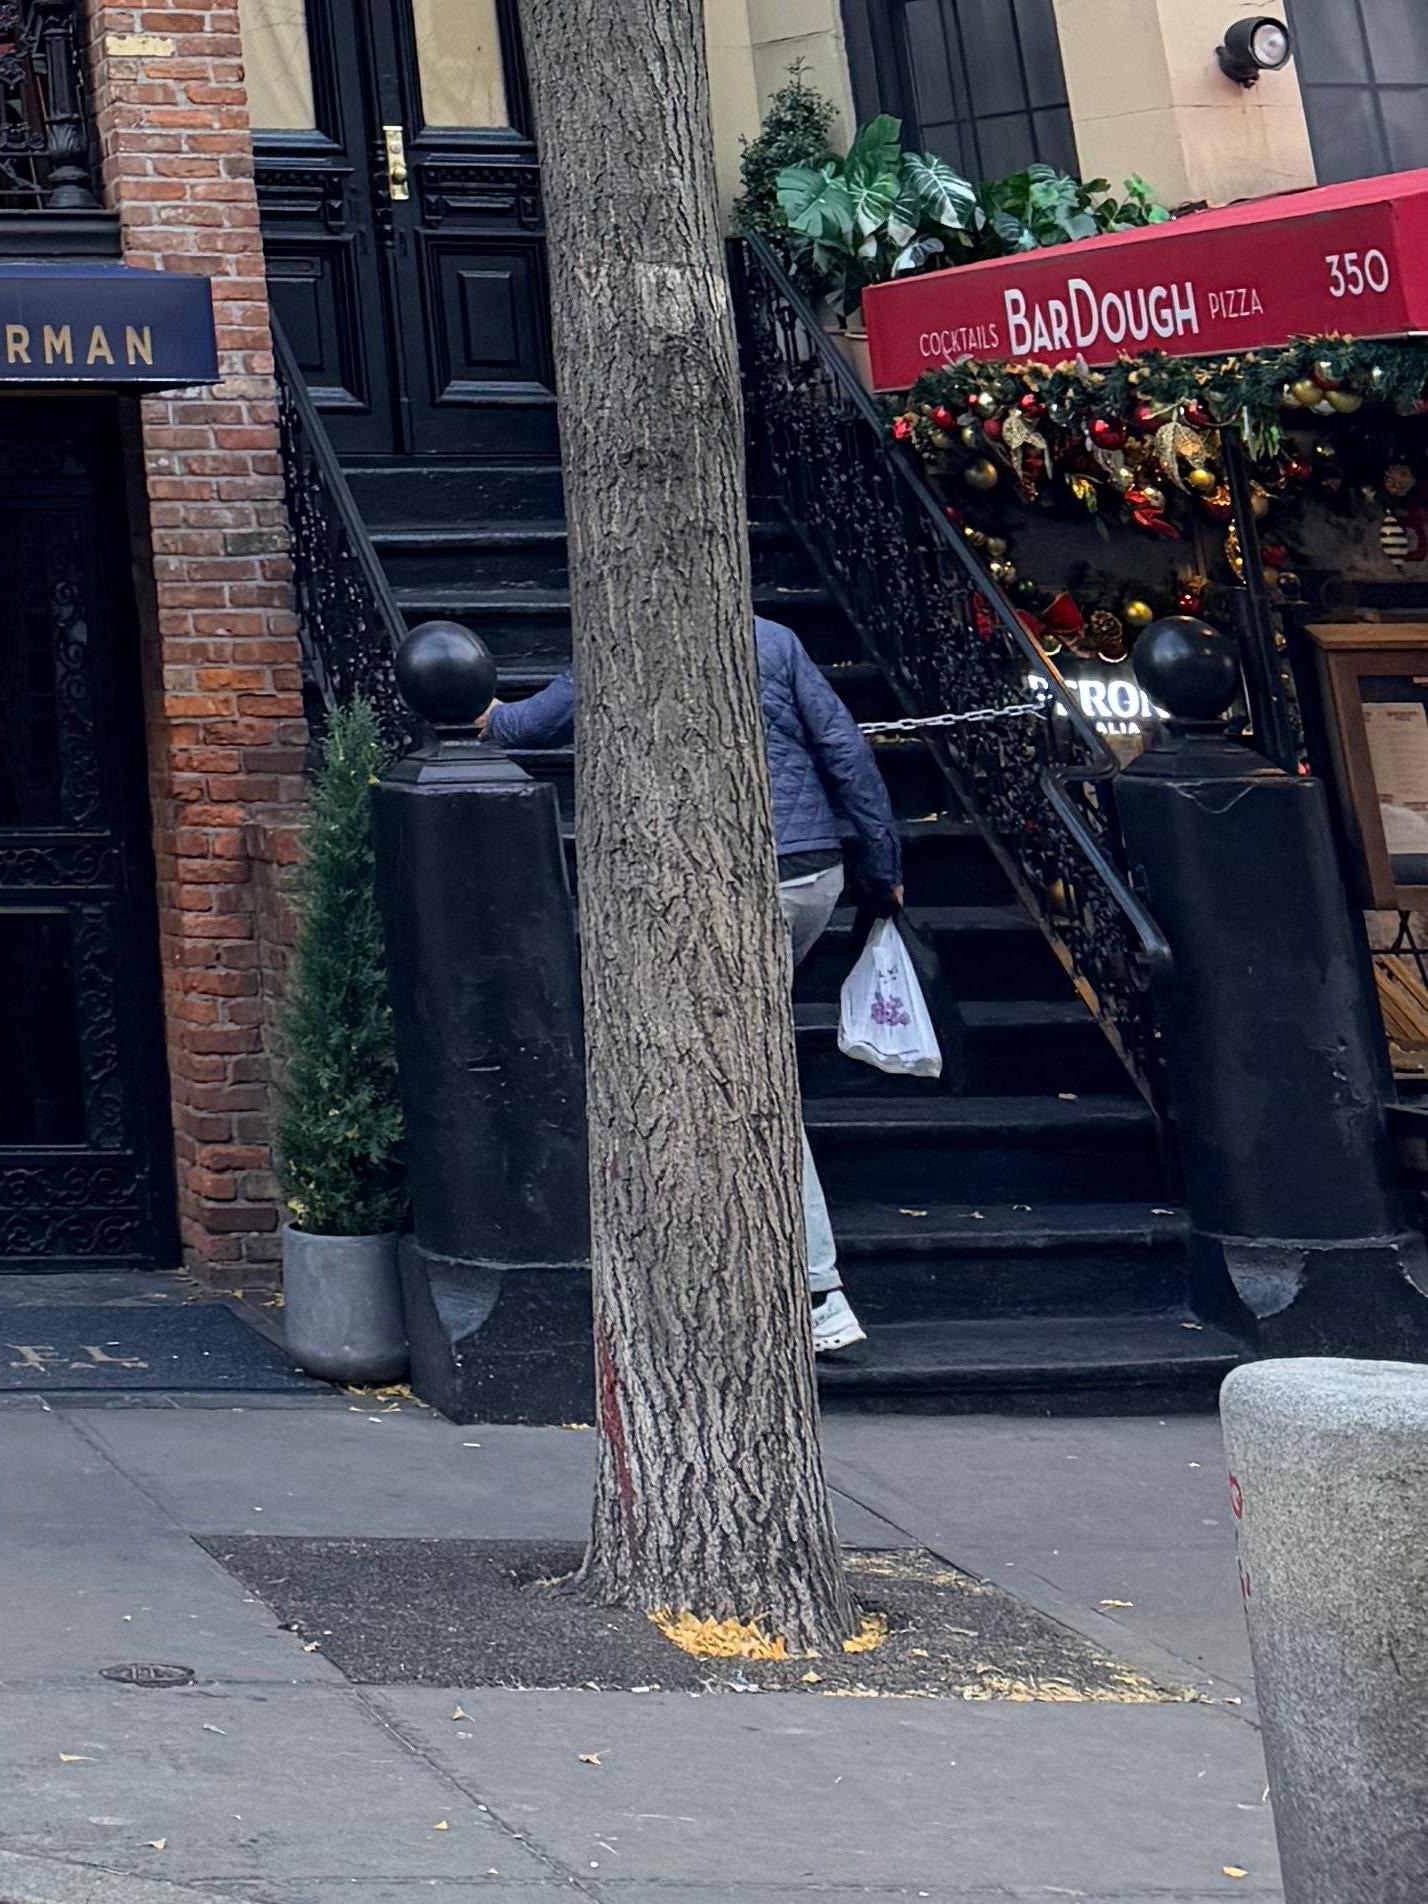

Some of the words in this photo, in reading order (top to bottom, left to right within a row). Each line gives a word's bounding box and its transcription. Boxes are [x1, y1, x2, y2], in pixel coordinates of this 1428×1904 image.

[1325, 248, 1390, 298] 350
[919, 323, 1000, 358] COCKTAILS
[1208, 288, 1263, 319] PIZZA
